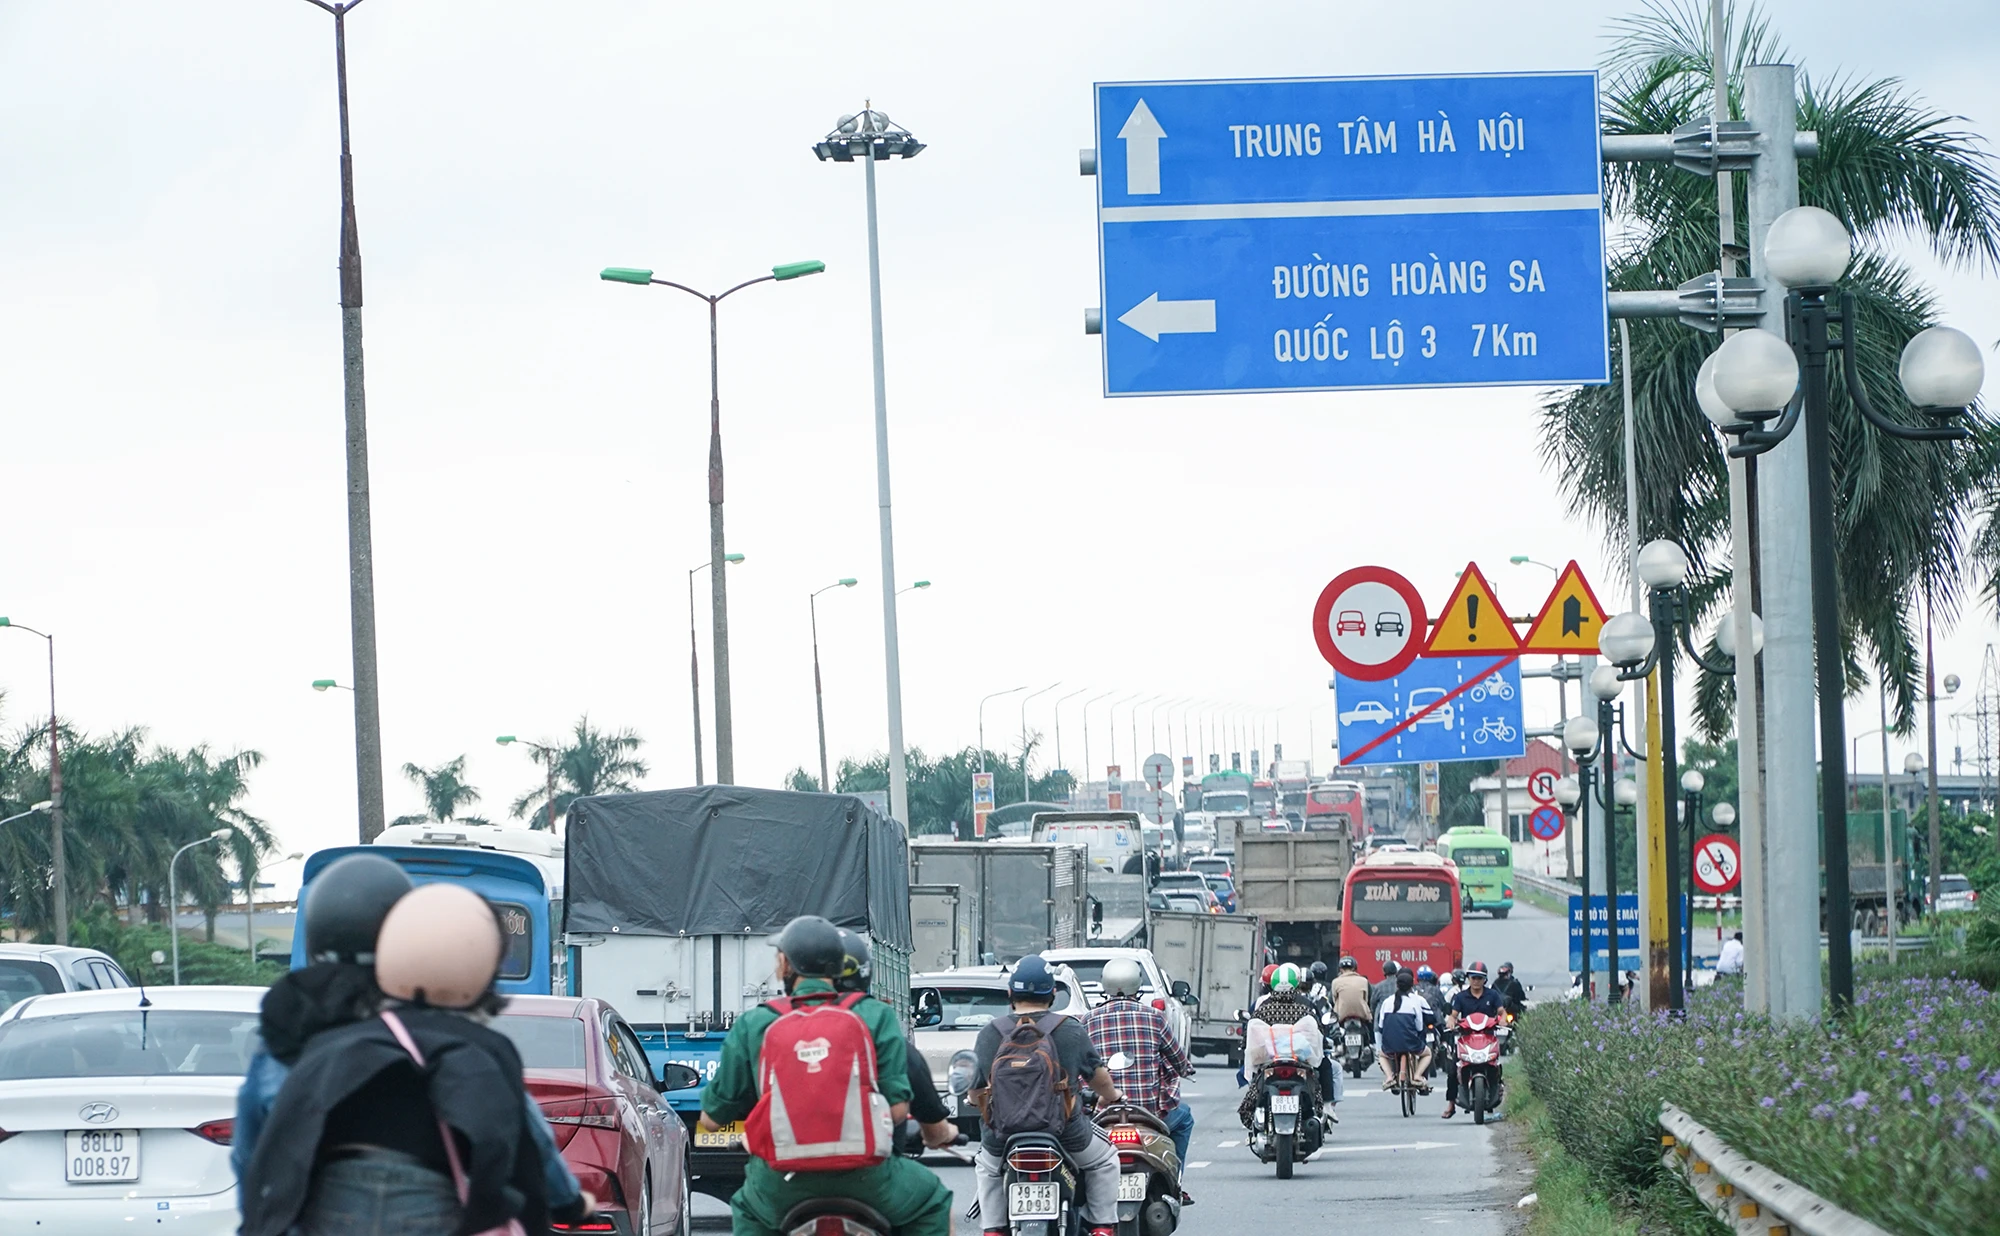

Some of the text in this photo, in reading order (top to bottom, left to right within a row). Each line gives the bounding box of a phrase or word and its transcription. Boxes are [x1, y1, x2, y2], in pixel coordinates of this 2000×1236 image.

[1229, 111, 1524, 158] TRUNG TÂM HÀ NỘI
[1272, 253, 1545, 299] ĐƯỜNG HOÀNG SA
[1274, 314, 1348, 362] QUỐC
[1371, 320, 1404, 366] LỘ
[1421, 326, 1437, 358] 3
[1364, 882, 1399, 901] XUÂN
[1574, 909, 1583, 921] XE
[81, 1133, 124, 1153] 88LD
[74, 1156, 131, 1177] 008.97
